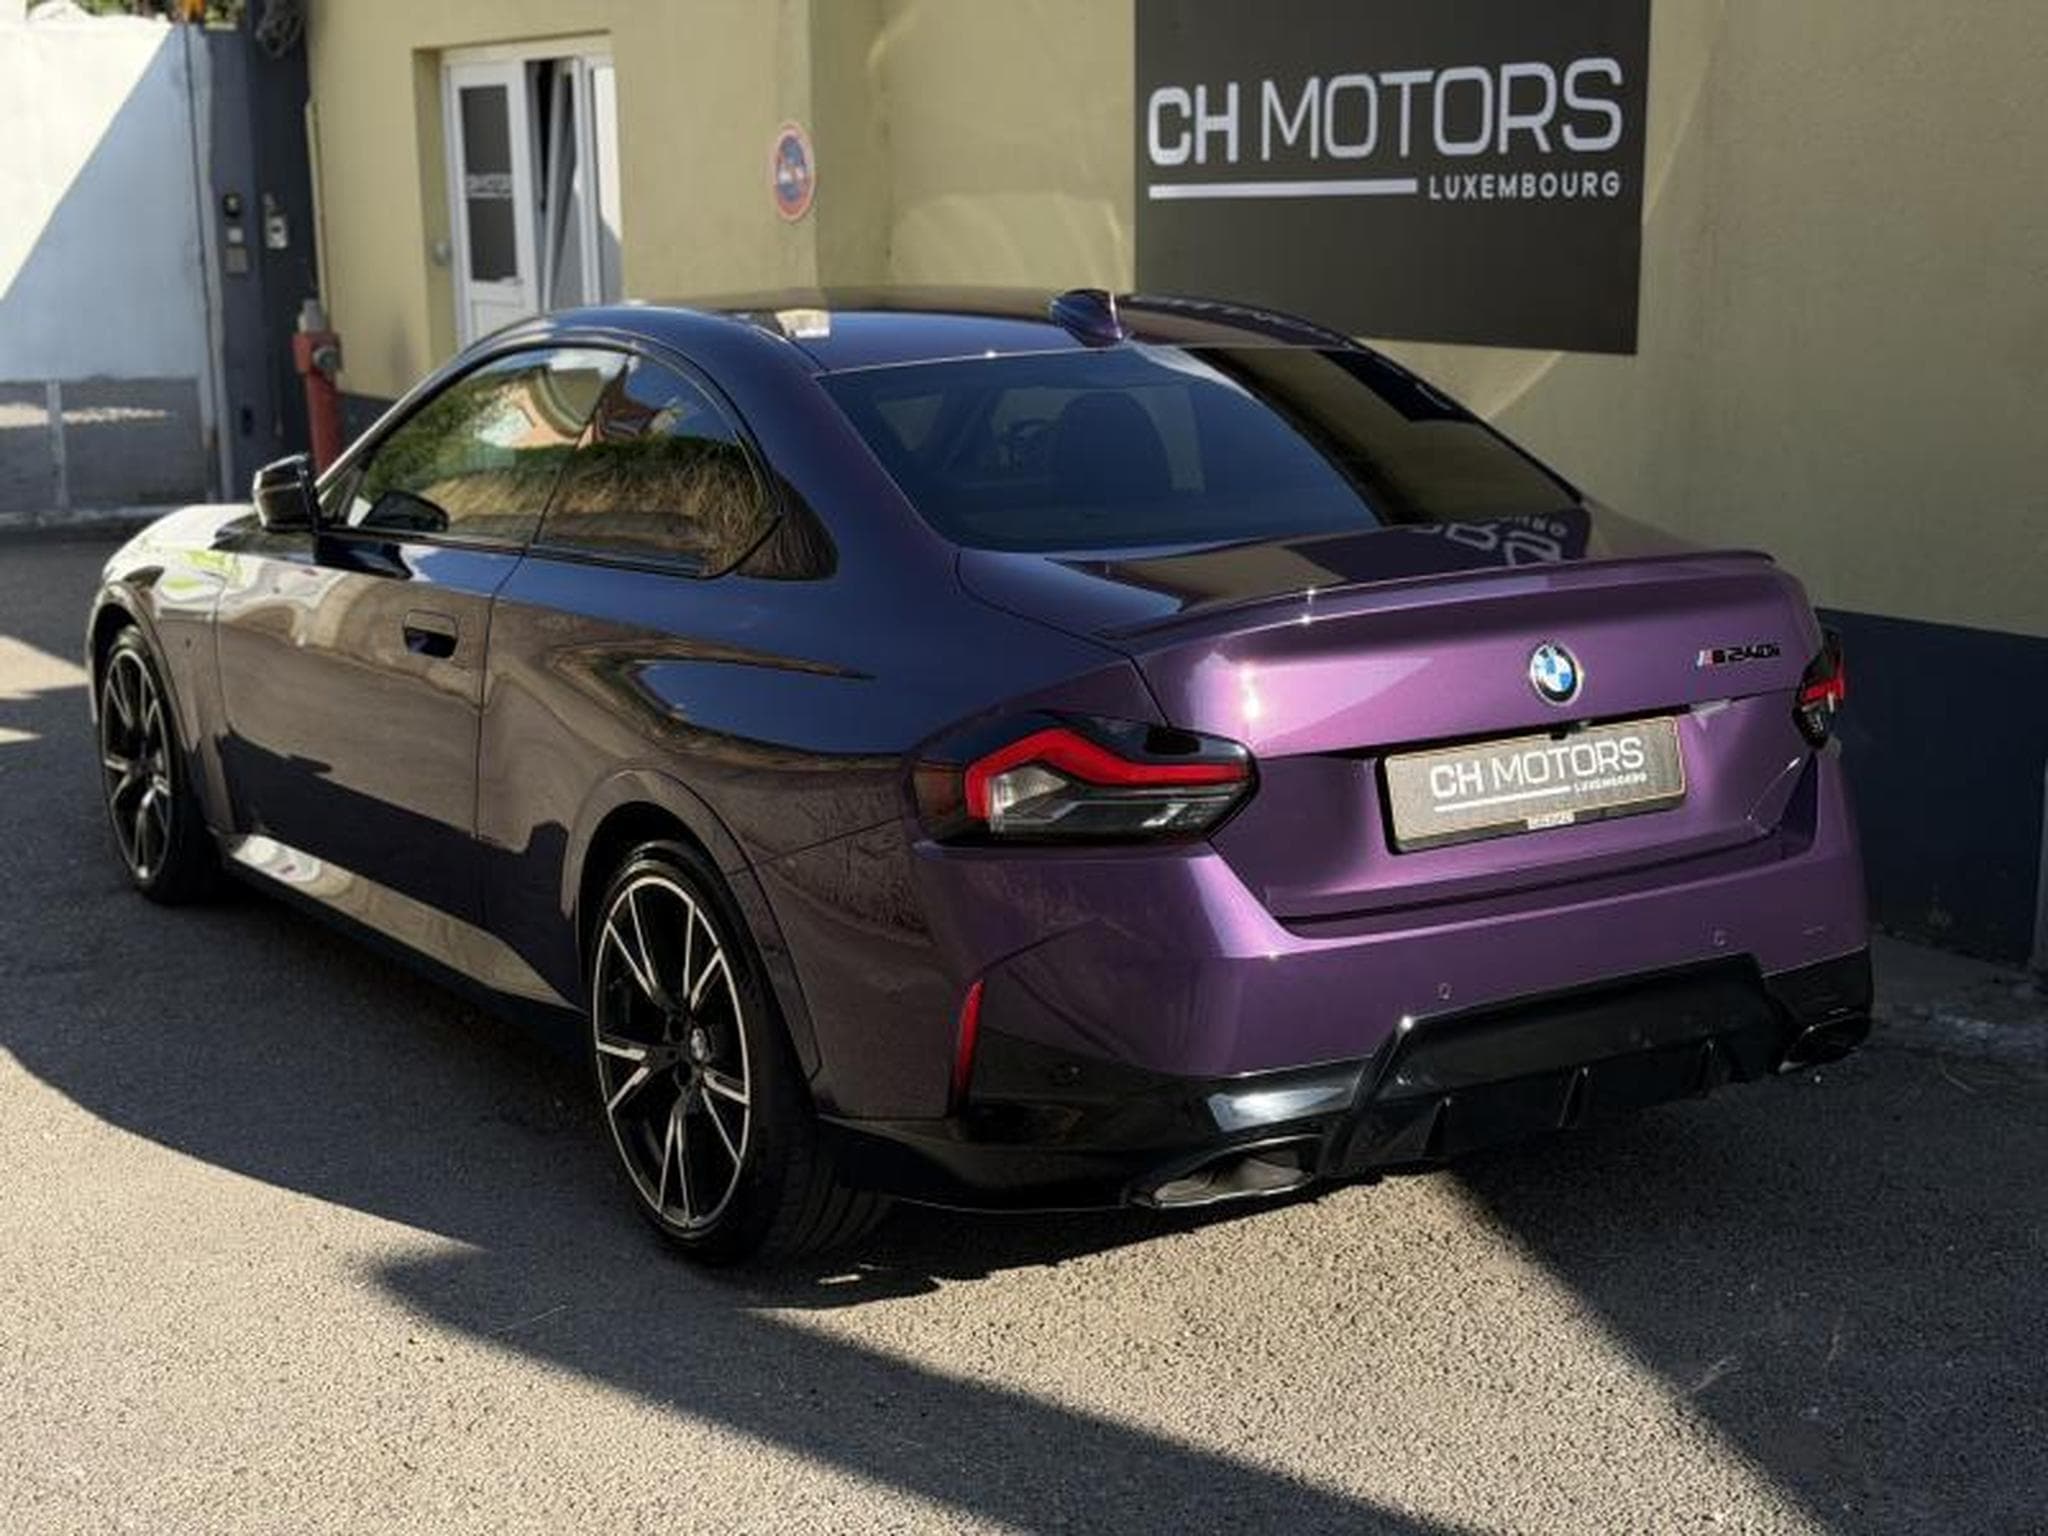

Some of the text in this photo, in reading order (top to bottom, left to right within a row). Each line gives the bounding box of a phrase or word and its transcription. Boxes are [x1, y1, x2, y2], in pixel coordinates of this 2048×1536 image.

[1148, 58, 1622, 166] CH MOTORS
[1429, 170, 1620, 200] LUXEMBOURG
[1430, 763, 1484, 800] CH
[1491, 736, 1645, 788] MOTORS
